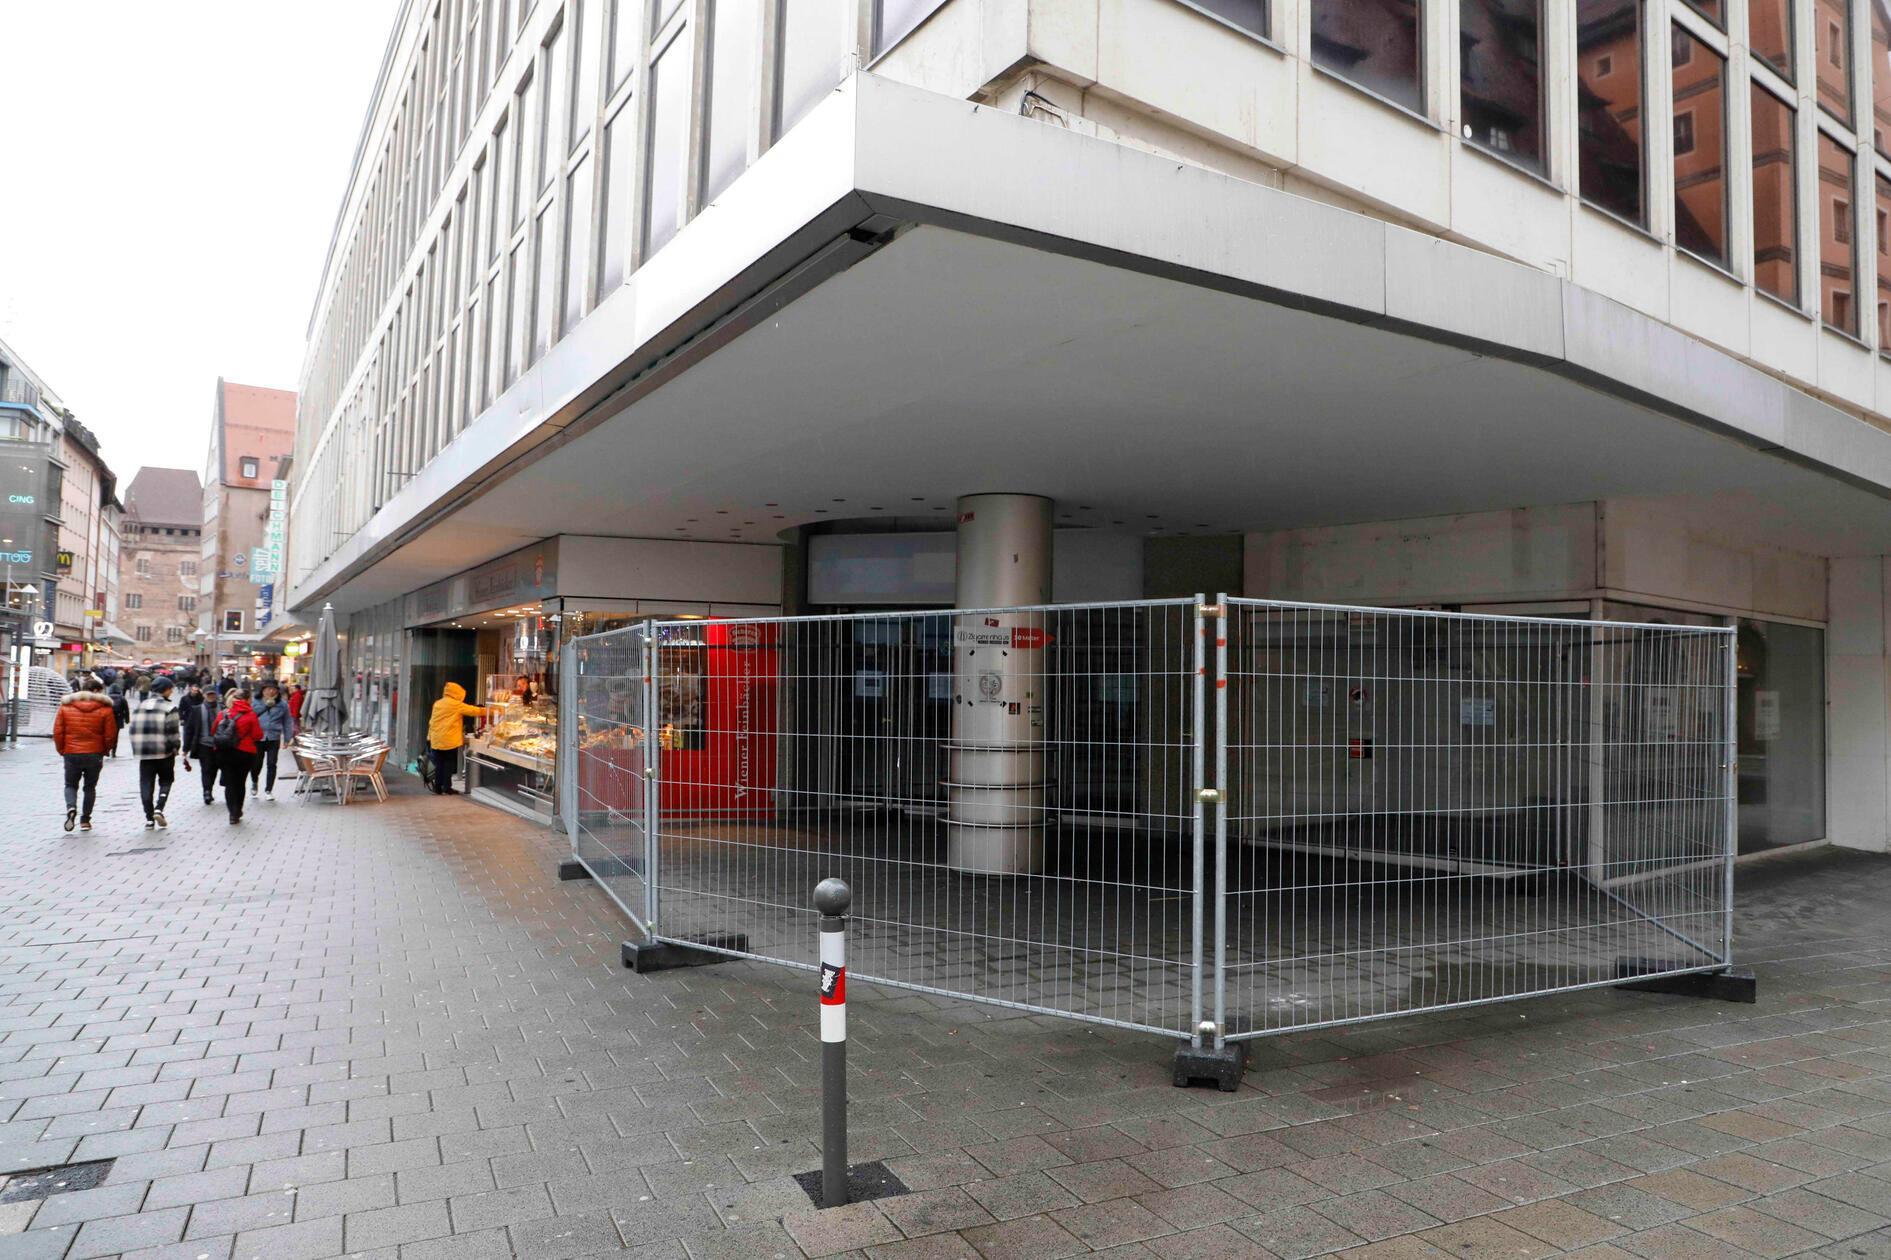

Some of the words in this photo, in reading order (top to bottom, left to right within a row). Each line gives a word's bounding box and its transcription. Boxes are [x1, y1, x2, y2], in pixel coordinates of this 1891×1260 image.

[9, 495, 34, 504] CING
[271, 482, 283, 571] DEICHMANN
[734, 745, 749, 800] Wiener
